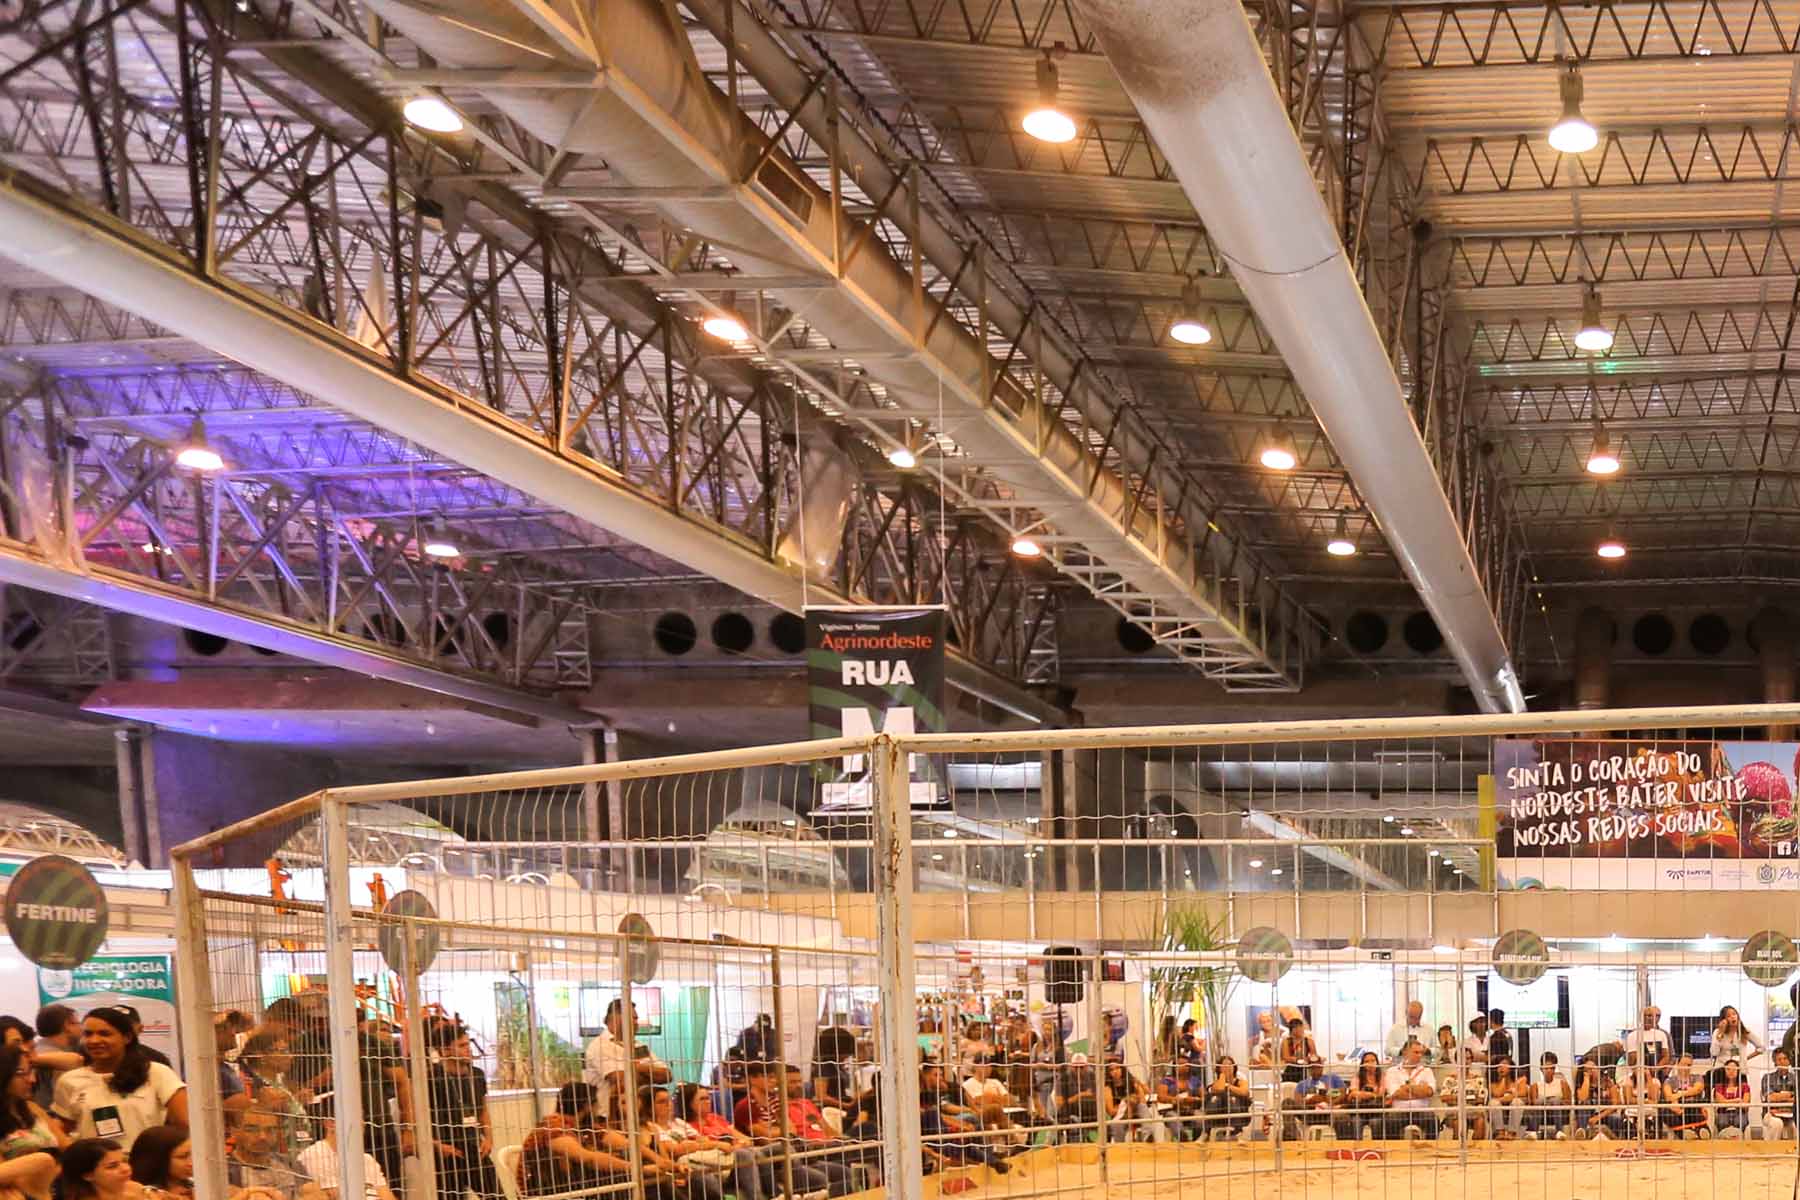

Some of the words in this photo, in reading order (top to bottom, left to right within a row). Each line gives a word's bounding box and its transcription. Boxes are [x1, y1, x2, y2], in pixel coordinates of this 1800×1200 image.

[822, 632, 933, 653] Agrinordeste
[841, 659, 915, 686] RUA
[841, 706, 916, 773] M
[1506, 760, 1565, 790] SINTA
[1571, 763, 1582, 783] O
[1588, 749, 1670, 784] CORAÇÃO
[1675, 750, 1701, 773] DO
[1510, 786, 1609, 820] NORDESTE
[1688, 774, 1748, 803] VISITE
[1513, 821, 1582, 848] NOSSAS
[1588, 813, 1650, 844] REDES
[1655, 808, 1726, 838] SOCIAIS.
[15, 903, 97, 924] FERTINE
